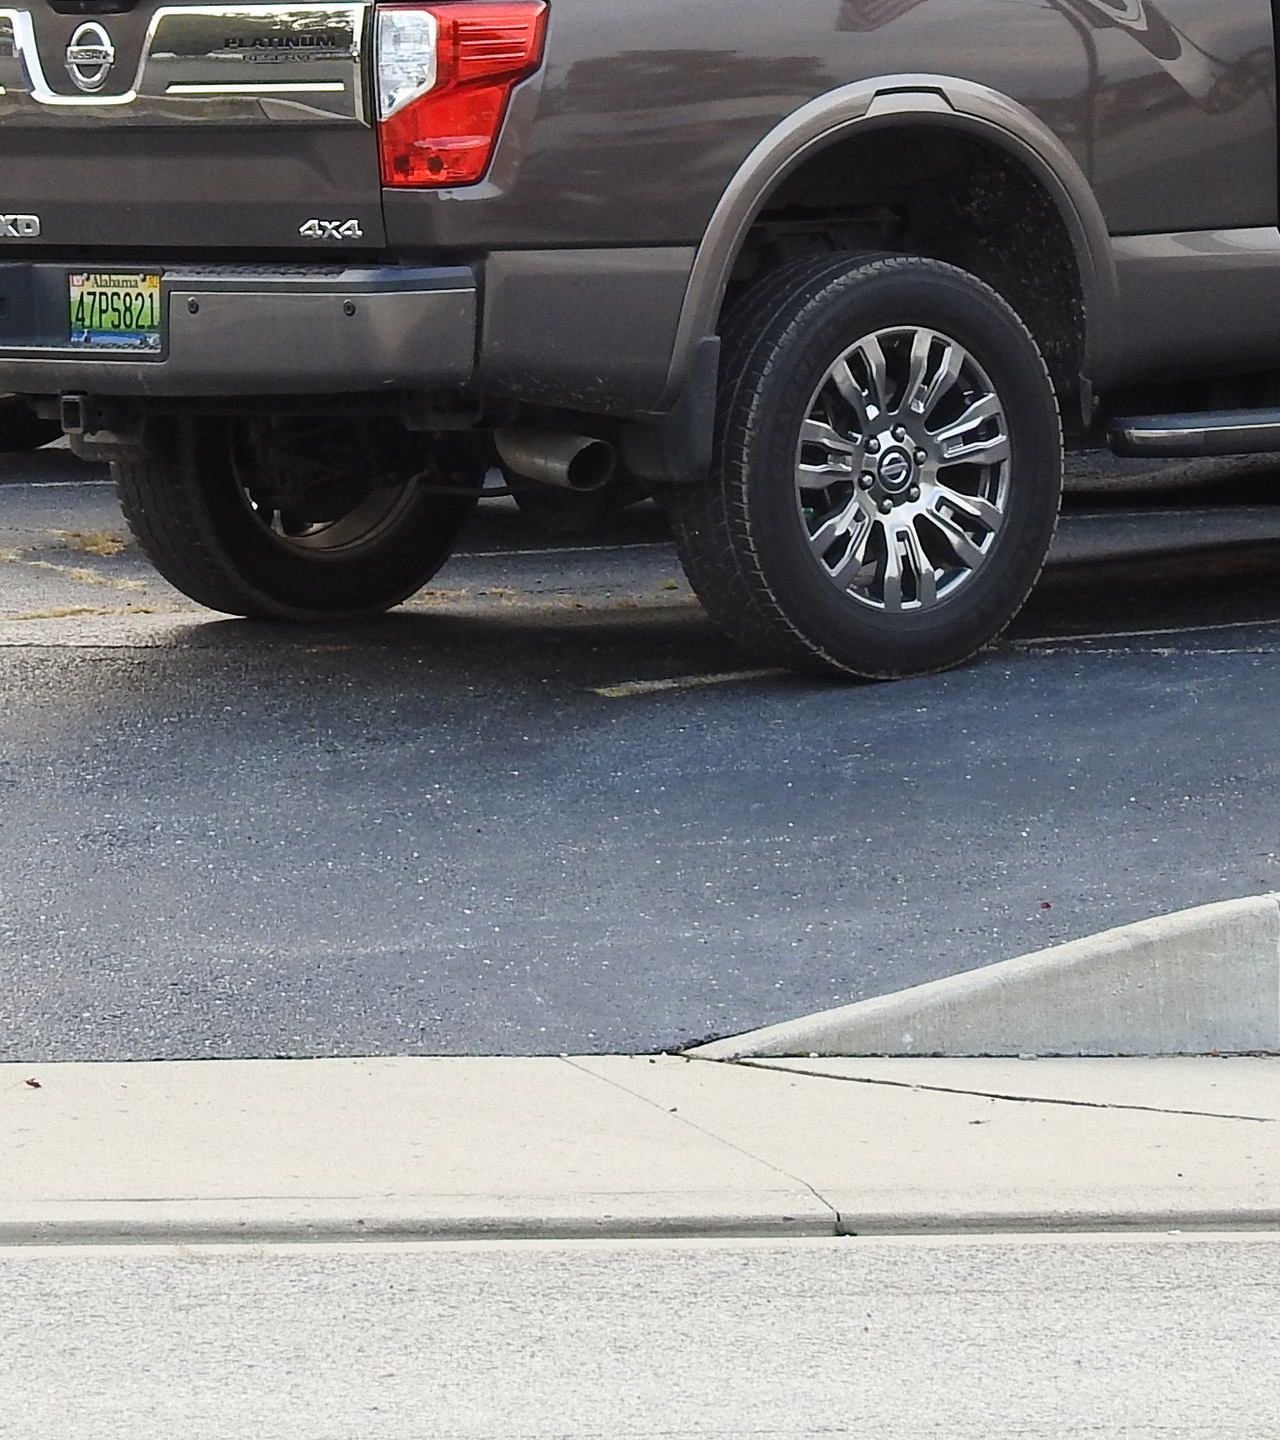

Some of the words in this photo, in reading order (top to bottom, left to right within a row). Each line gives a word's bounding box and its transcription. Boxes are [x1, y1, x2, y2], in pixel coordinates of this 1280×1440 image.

[70, 48, 111, 60] NISSAN
[92, 273, 139, 288] Alabama
[75, 291, 157, 329] 47PS821
